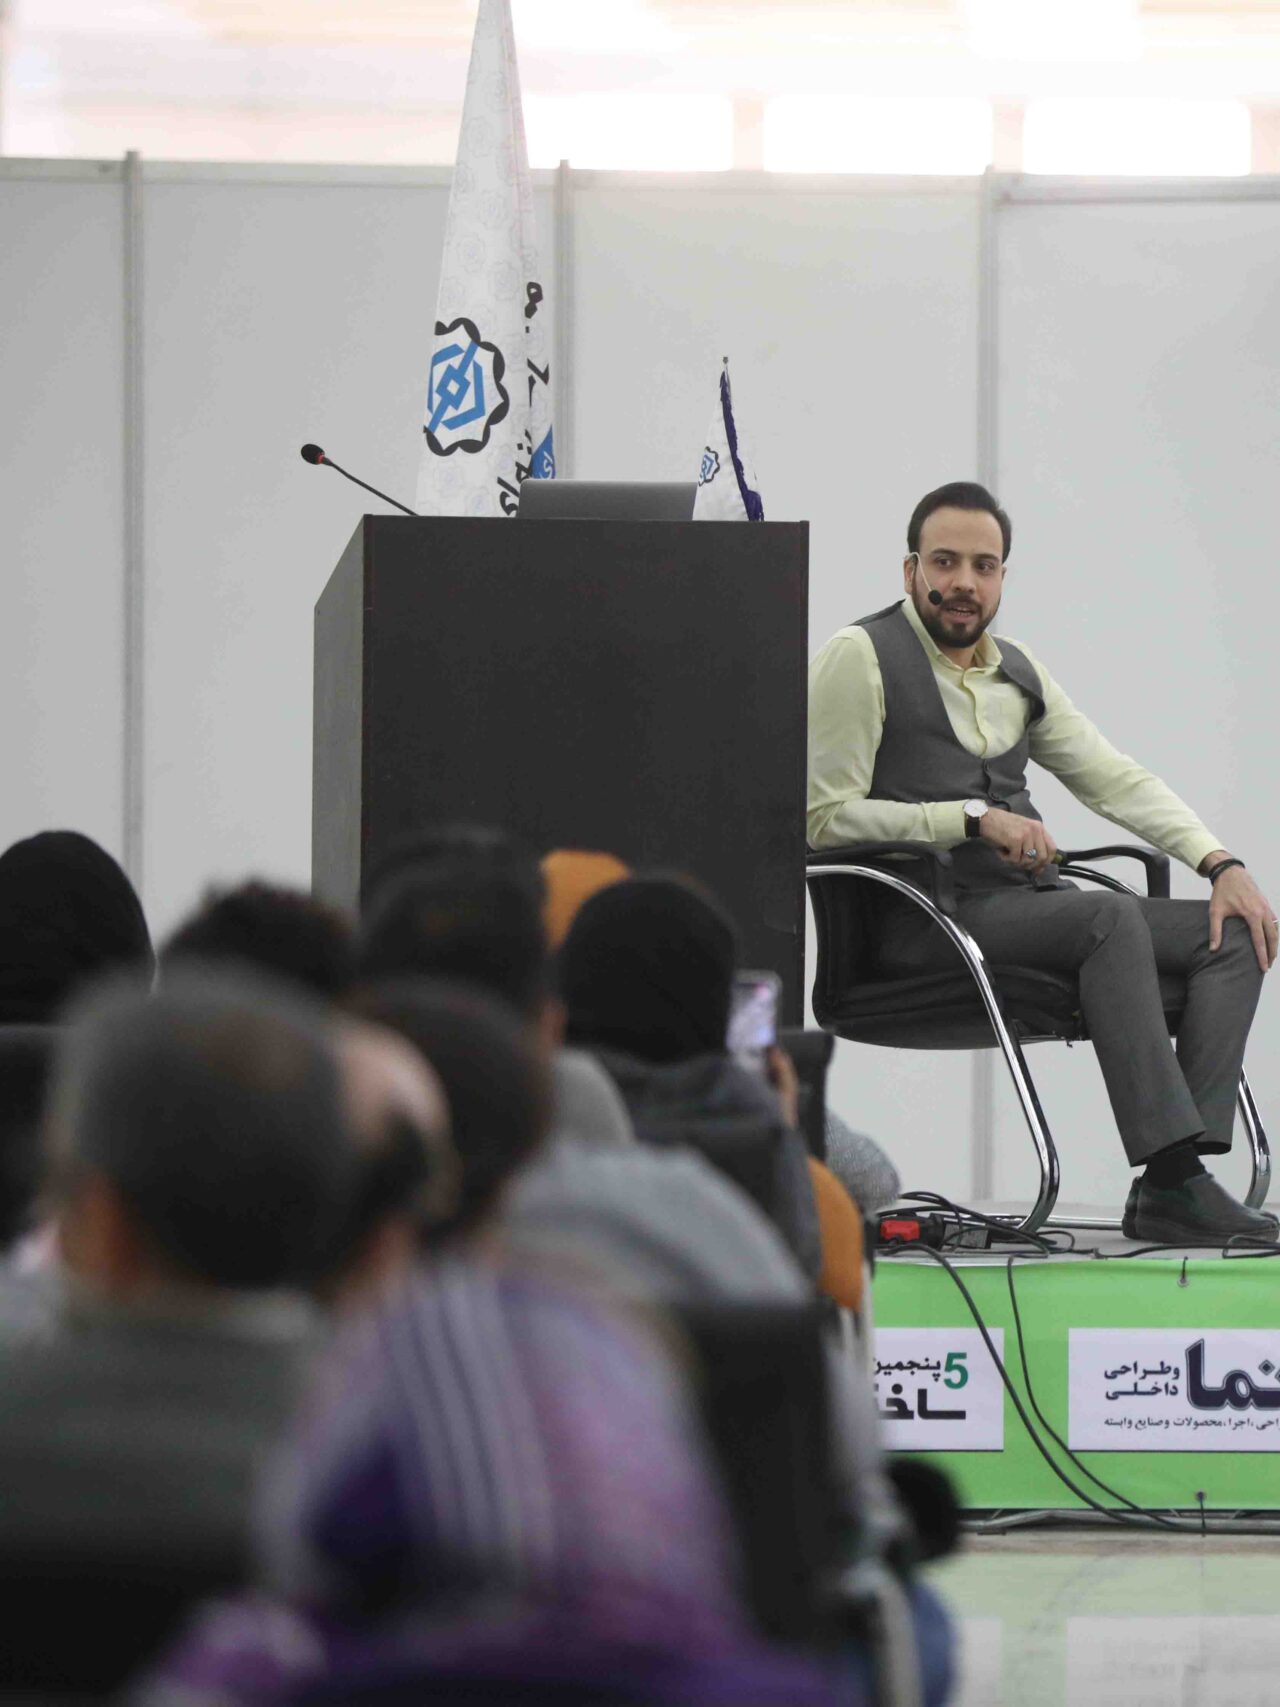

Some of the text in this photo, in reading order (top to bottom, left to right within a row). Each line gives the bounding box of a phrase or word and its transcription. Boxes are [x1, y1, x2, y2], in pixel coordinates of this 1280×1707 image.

[944, 1352, 969, 1390] 5
[1105, 1380, 1179, 1401] داخلی
[1103, 1417, 1133, 1429] وابسته
